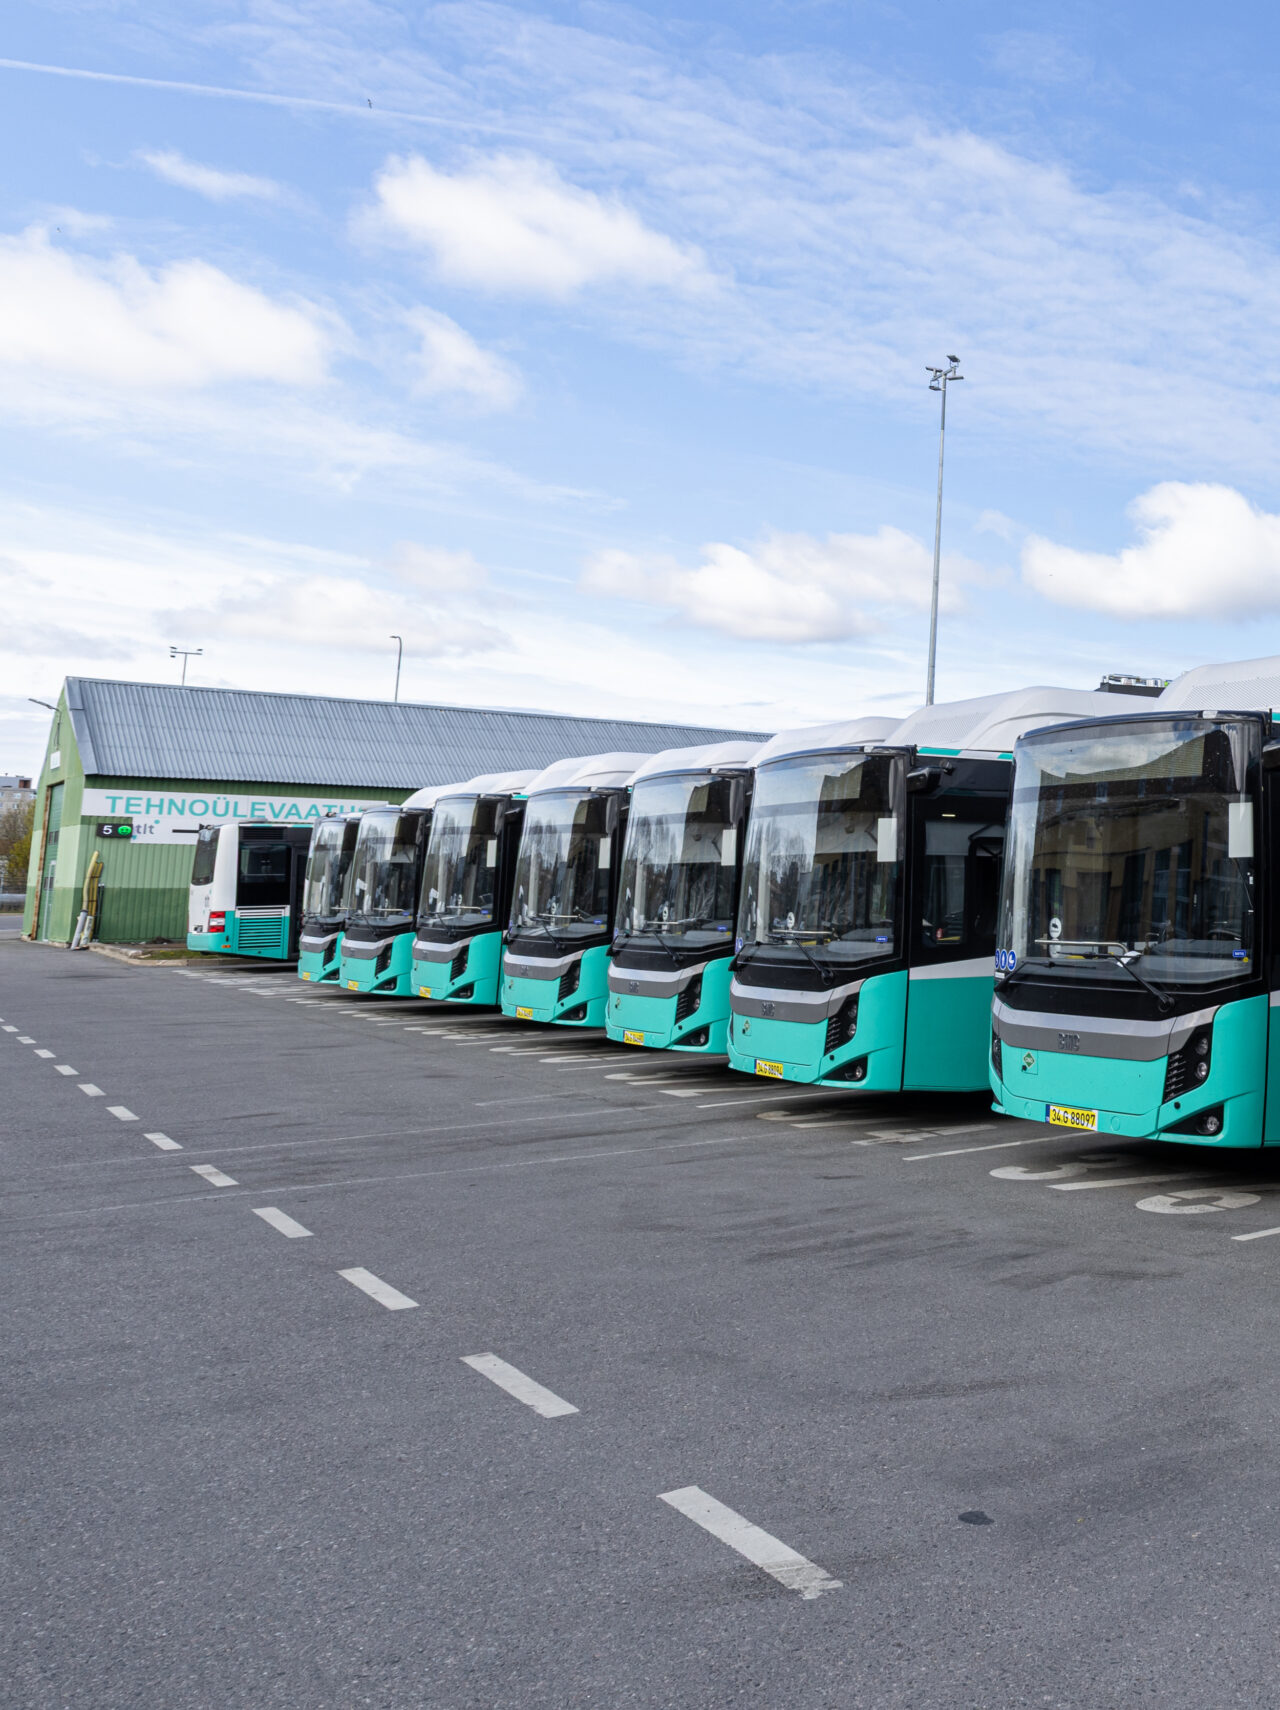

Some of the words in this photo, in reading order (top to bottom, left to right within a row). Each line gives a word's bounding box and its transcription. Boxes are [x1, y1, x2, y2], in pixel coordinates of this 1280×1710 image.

[105, 795, 366, 820] TEHNOÜLEVAATU
[103, 825, 113, 835] 5
[1052, 1109, 1061, 1123] 34
[1071, 1112, 1095, 1128] 88097
